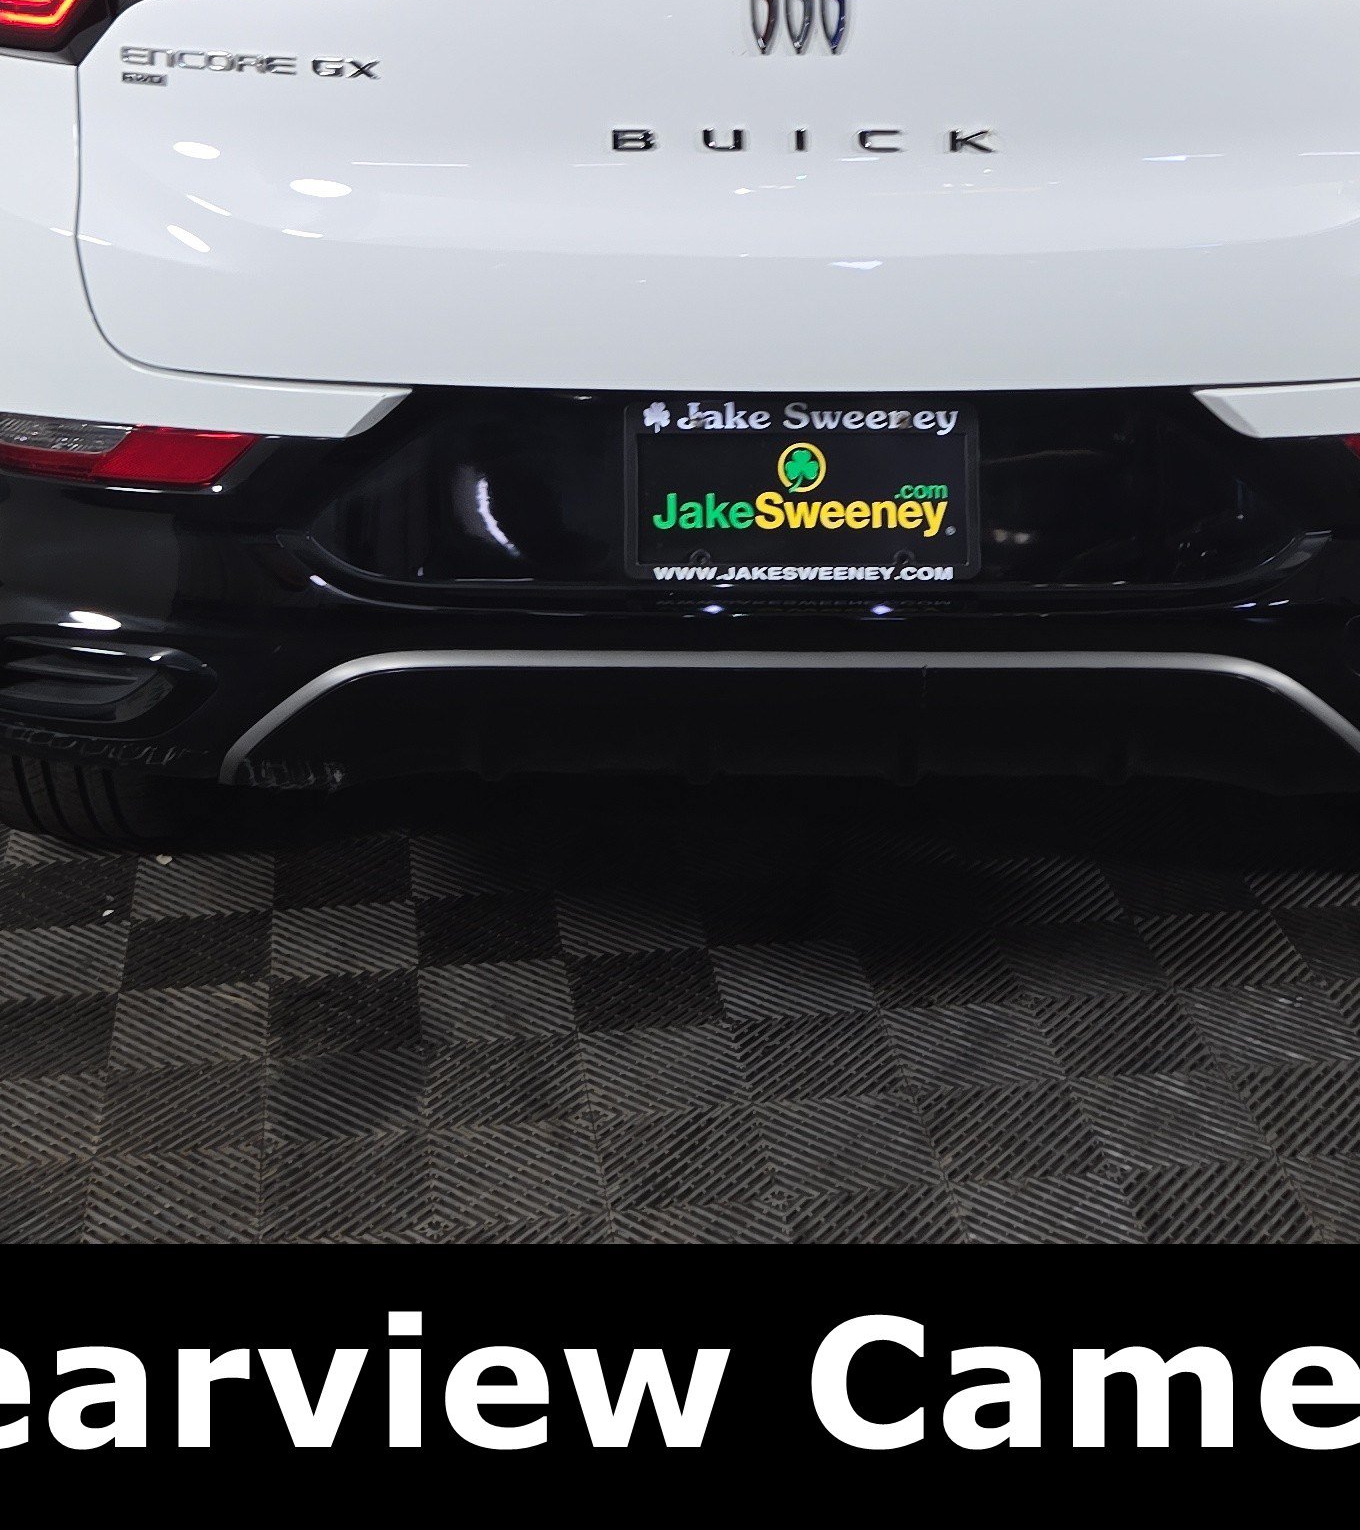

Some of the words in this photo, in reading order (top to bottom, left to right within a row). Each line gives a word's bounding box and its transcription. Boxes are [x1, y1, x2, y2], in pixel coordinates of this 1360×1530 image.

[121, 46, 297, 75] ENCORE
[312, 56, 381, 80] GX
[611, 127, 997, 153] BUICK
[676, 402, 772, 430] Jake
[782, 402, 959, 436] Sweeney
[894, 484, 949, 500] .com
[652, 491, 948, 538] JakeSweeney
[653, 566, 954, 581] WWW.JAKESWEENEY.COM
